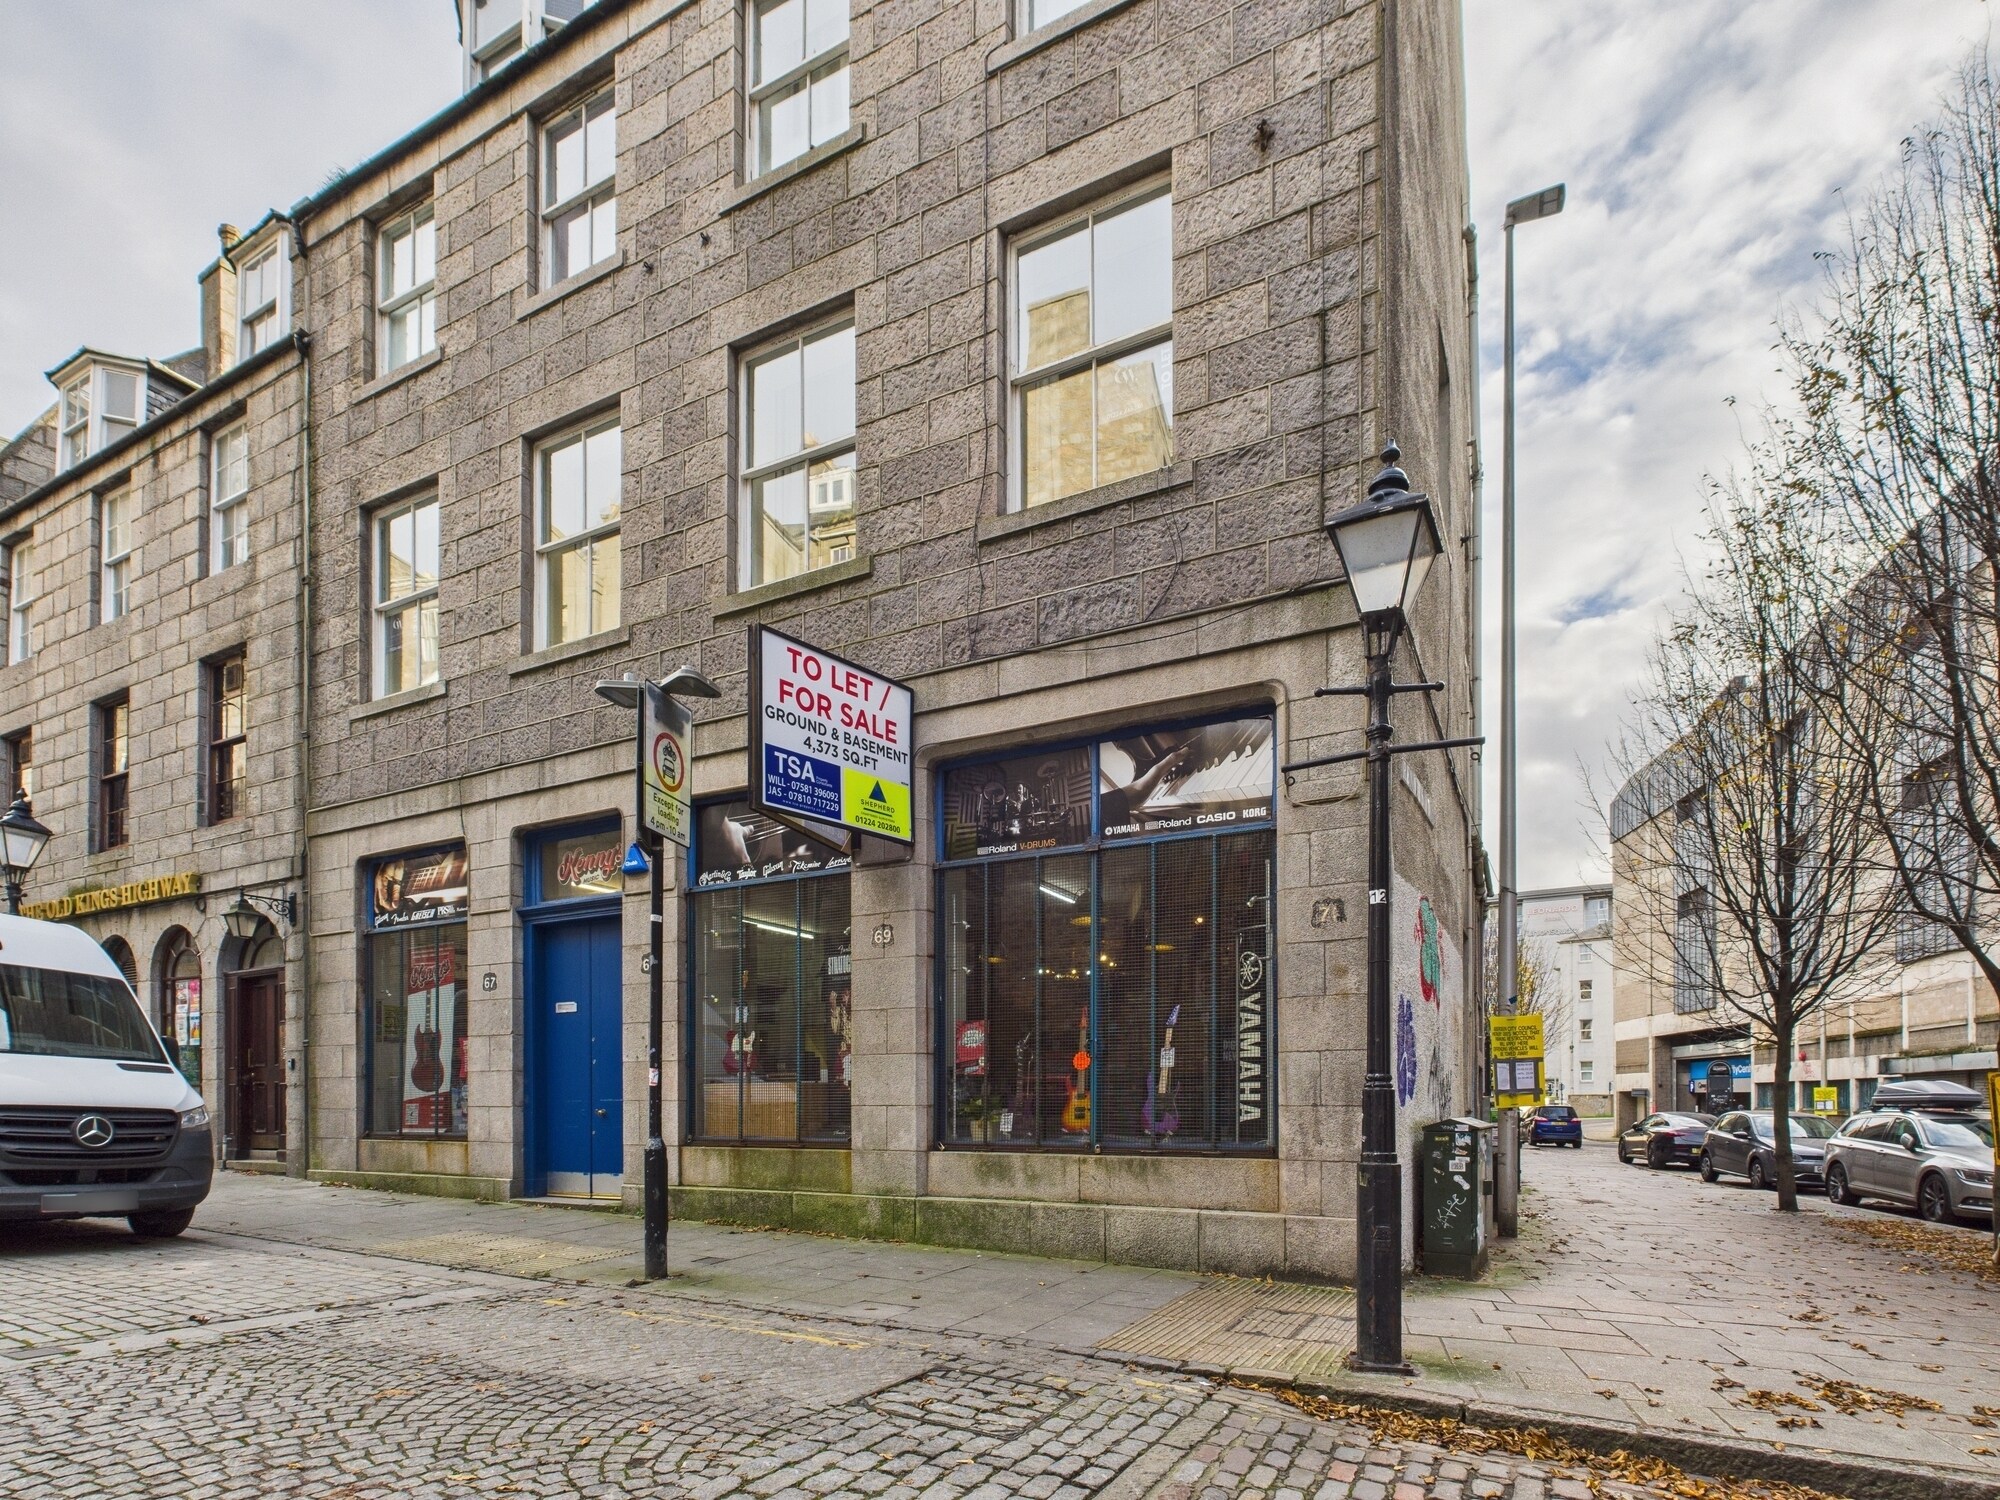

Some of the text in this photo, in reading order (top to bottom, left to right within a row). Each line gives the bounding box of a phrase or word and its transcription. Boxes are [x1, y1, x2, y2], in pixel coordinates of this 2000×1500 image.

[787, 646, 891, 711] TO LET /
[779, 678, 897, 744] FOR SALE
[765, 704, 909, 765] GROUND & BASEMENT
[803, 736, 879, 771] 4,373 SQ.FT
[774, 751, 815, 783] TSA
[767, 773, 786, 787] WILL
[791, 781, 813, 794] 07581
[814, 787, 839, 802] 396092
[767, 785, 783, 797] JAS
[788, 791, 812, 805] 07810
[813, 798, 839, 812] 717229
[653, 792, 684, 816] Except for
[657, 806, 680, 826] loading
[860, 798, 895, 814] SHEPHERD
[650, 816, 655, 826] 4
[656, 821, 665, 831] pm
[669, 824, 676, 836] 10
[677, 831, 686, 841] am
[855, 815, 876, 827] 01224
[877, 822, 901, 834] 202800
[1113, 806, 1267, 834] YAMAHA Roland CASIO KORG
[988, 838, 1056, 854] Roland V-DRUMS
[583, 874, 600, 883] MUSIC
[737, 867, 757, 879] Taylor
[763, 861, 784, 877] Gibson
[19, 871, 193, 919] THE OLD KINGS HIGHWAY
[1370, 890, 1386, 903] 12
[874, 928, 892, 944] 69
[642, 959, 650, 971] 6
[484, 977, 496, 989] 67
[1239, 991, 1261, 1123] YAMAHA
